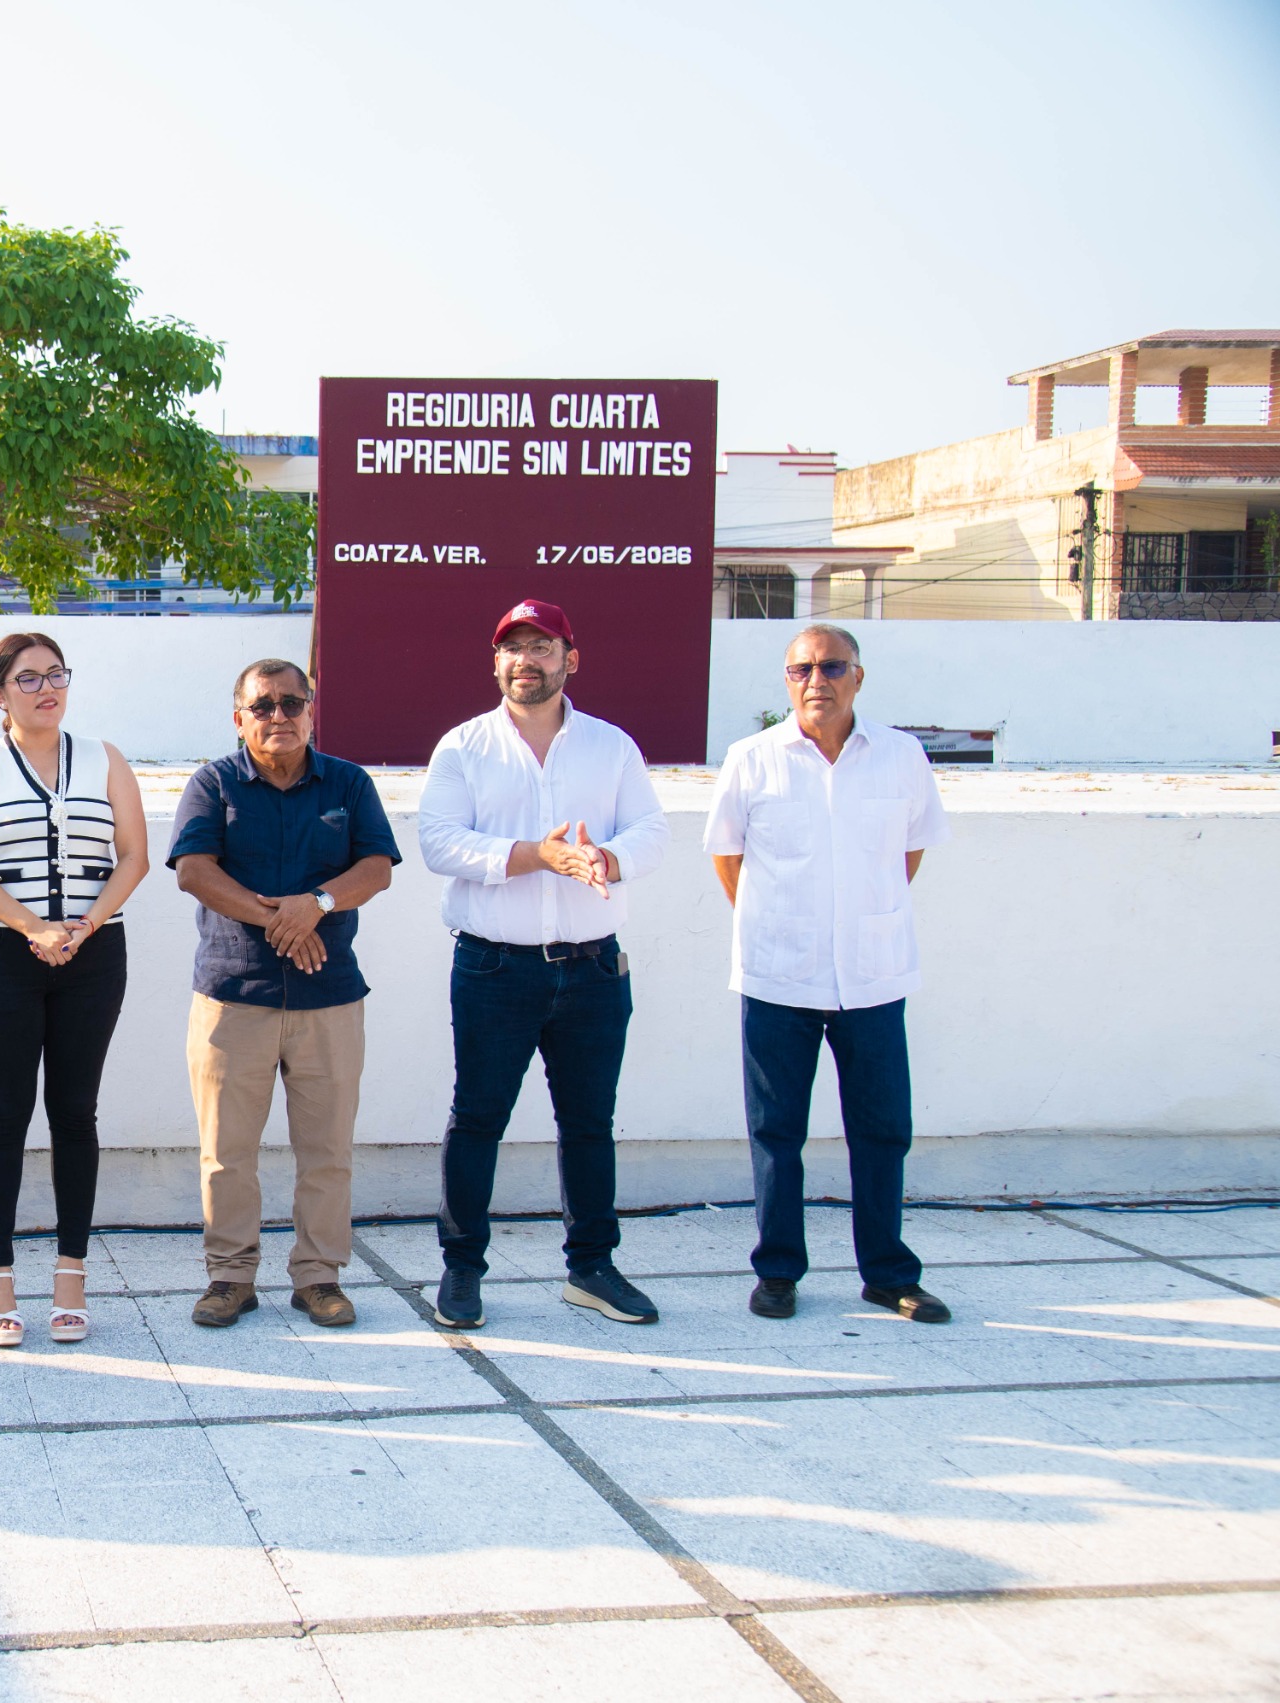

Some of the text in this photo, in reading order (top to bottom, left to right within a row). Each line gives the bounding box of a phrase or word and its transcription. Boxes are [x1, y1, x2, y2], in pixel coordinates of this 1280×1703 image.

[386, 392, 660, 429] REGIDURIA CUARTA
[356, 438, 692, 476] EMPRENDE SIN LIMITES
[536, 545, 692, 565] 17/05/2026
